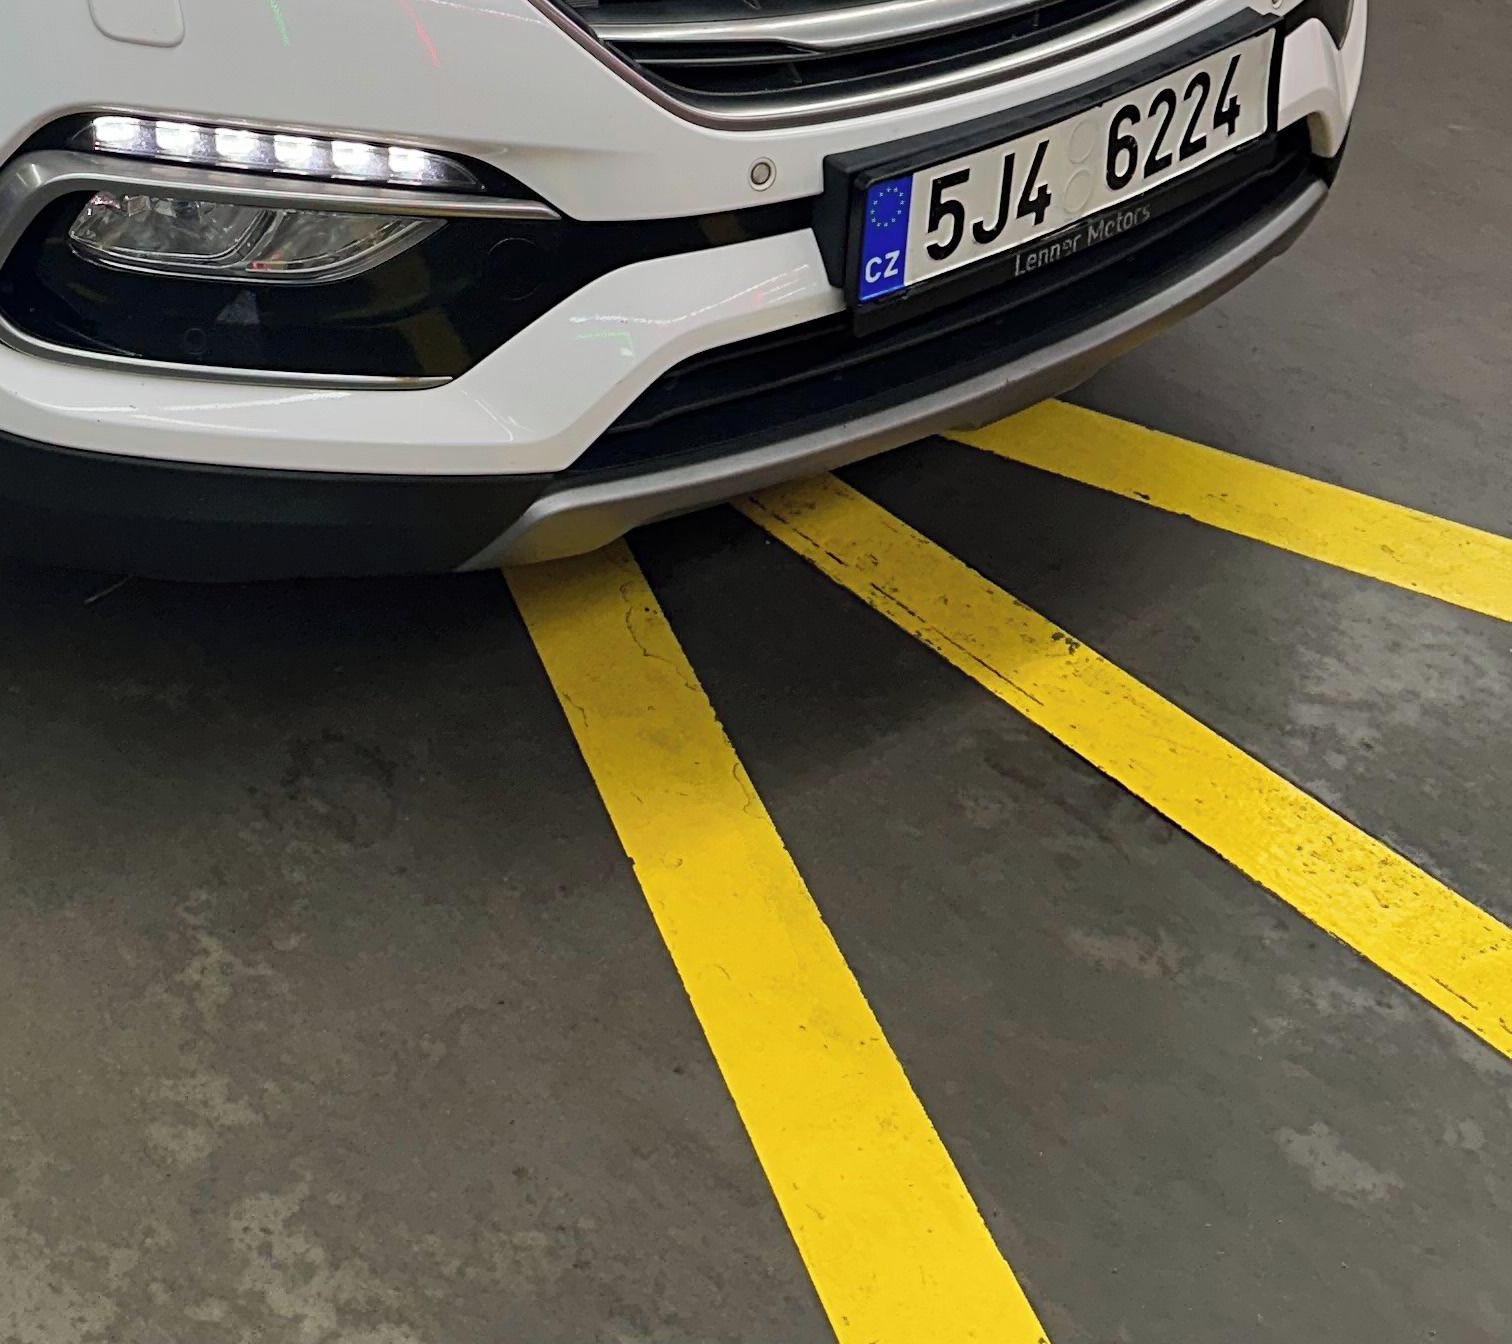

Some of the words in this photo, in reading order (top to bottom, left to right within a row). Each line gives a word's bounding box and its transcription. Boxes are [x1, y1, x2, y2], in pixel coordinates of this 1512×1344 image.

[926, 139, 1052, 261] 5J4
[1105, 53, 1242, 191] 6224
[864, 249, 901, 284] CZ
[1014, 233, 1083, 278] Lenner
[1087, 204, 1151, 247] Motors
